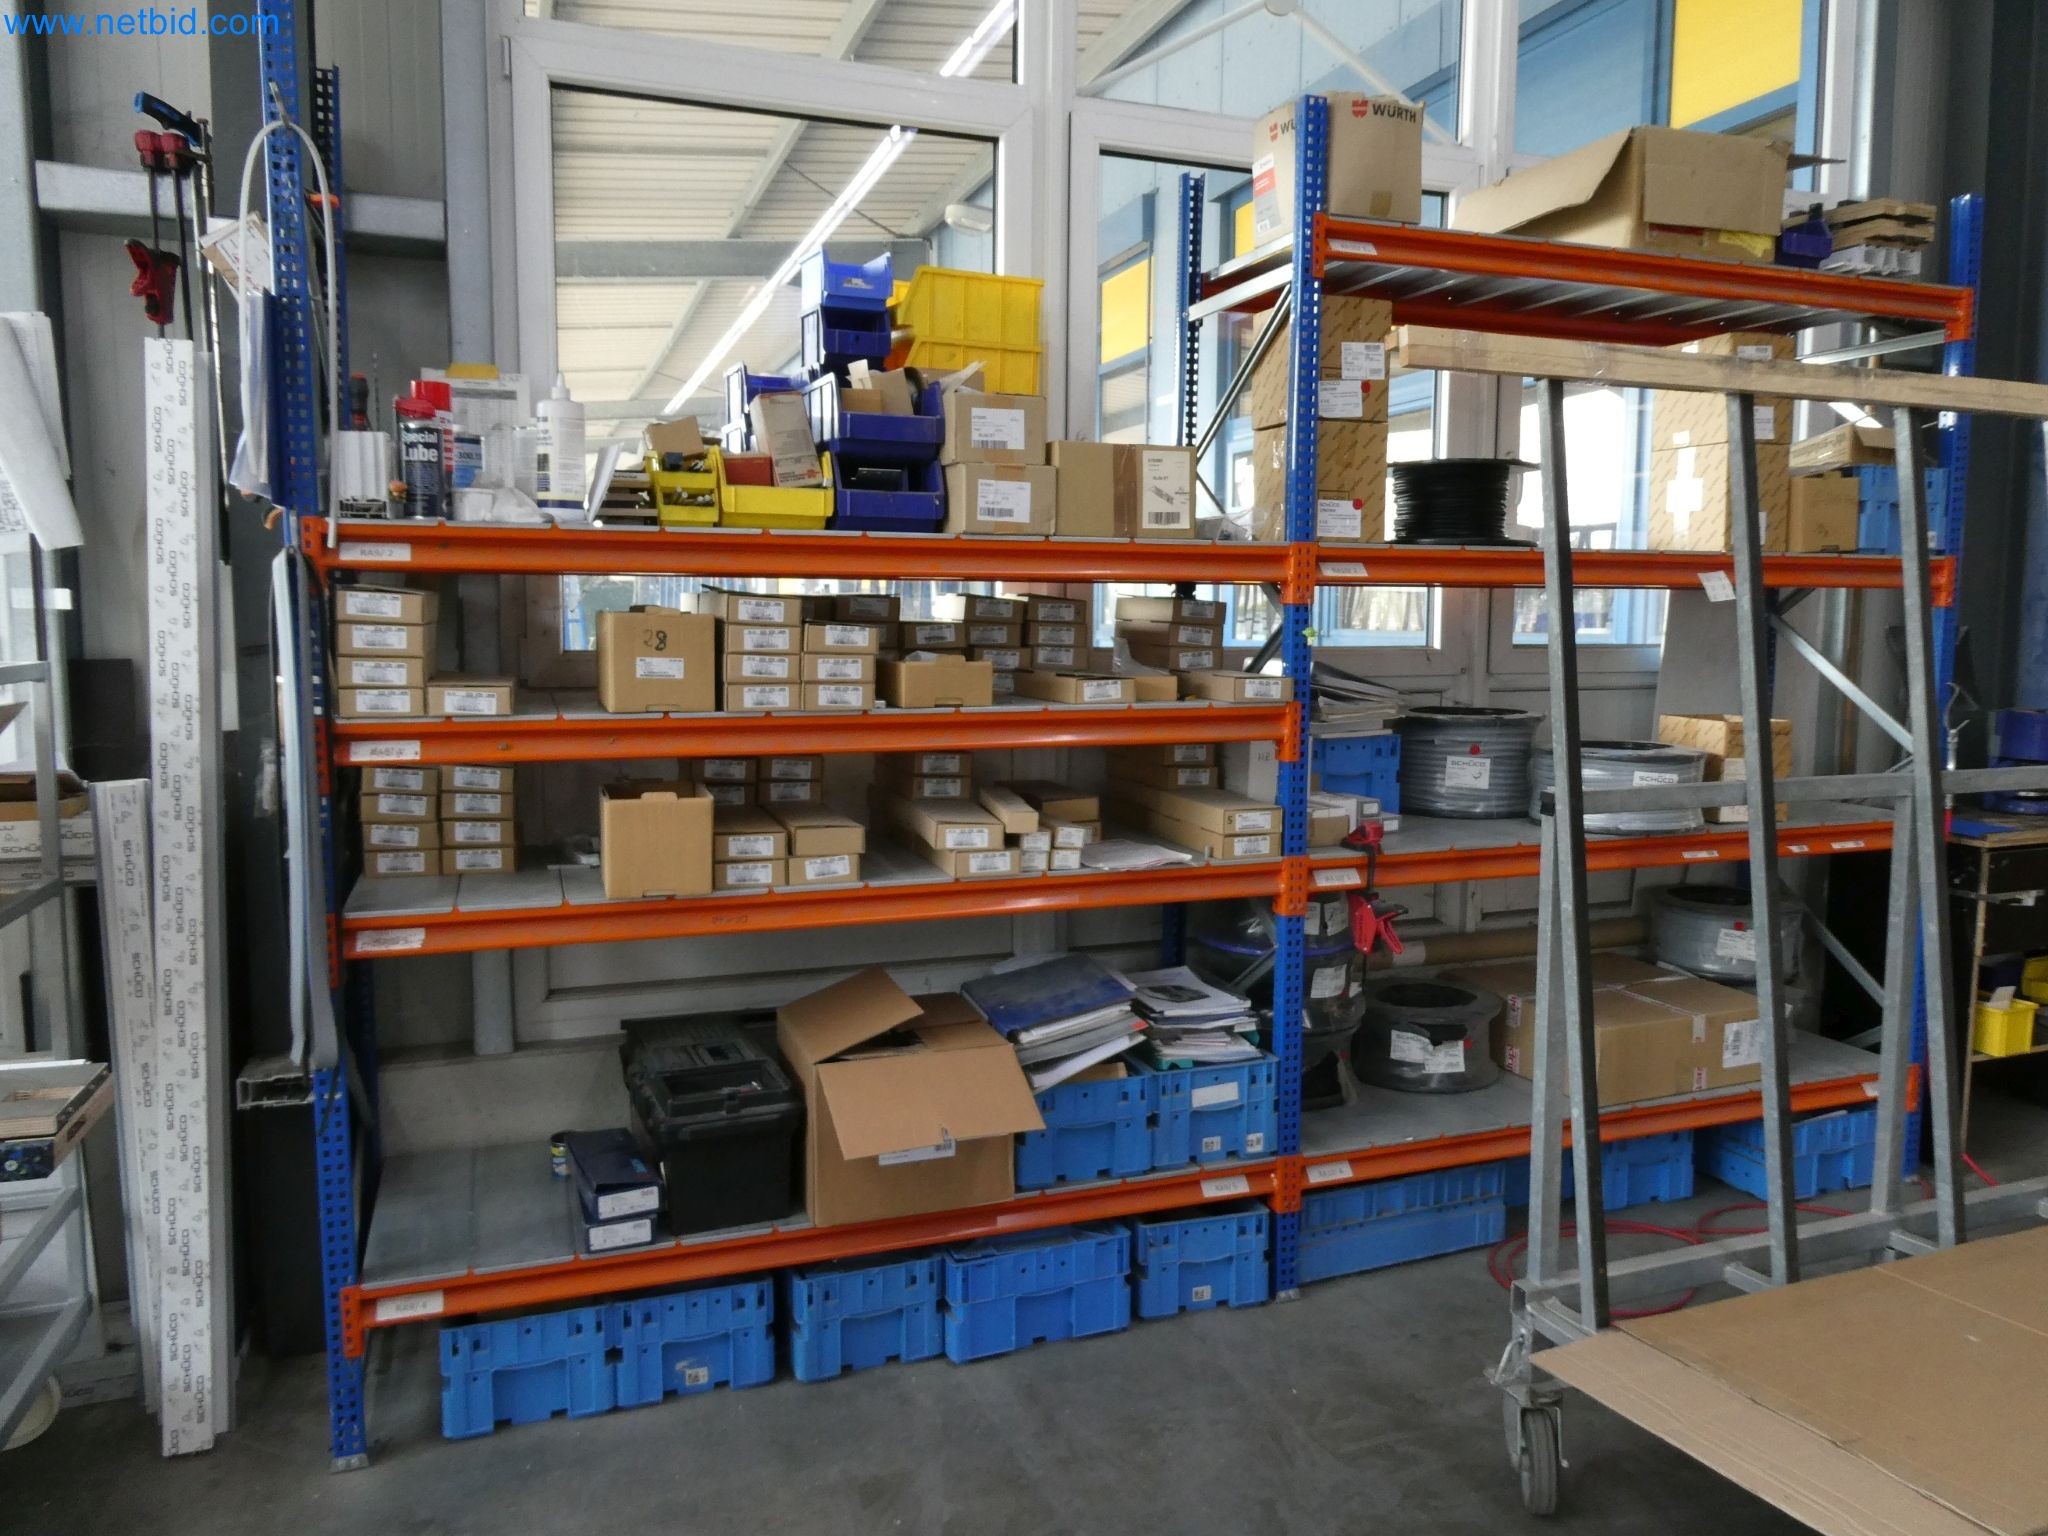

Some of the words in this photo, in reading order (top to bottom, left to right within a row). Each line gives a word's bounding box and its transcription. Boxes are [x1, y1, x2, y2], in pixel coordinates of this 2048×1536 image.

[1372, 103, 1417, 123] WÜRTH
[402, 430, 438, 444] Special
[402, 443, 438, 461] Lube
